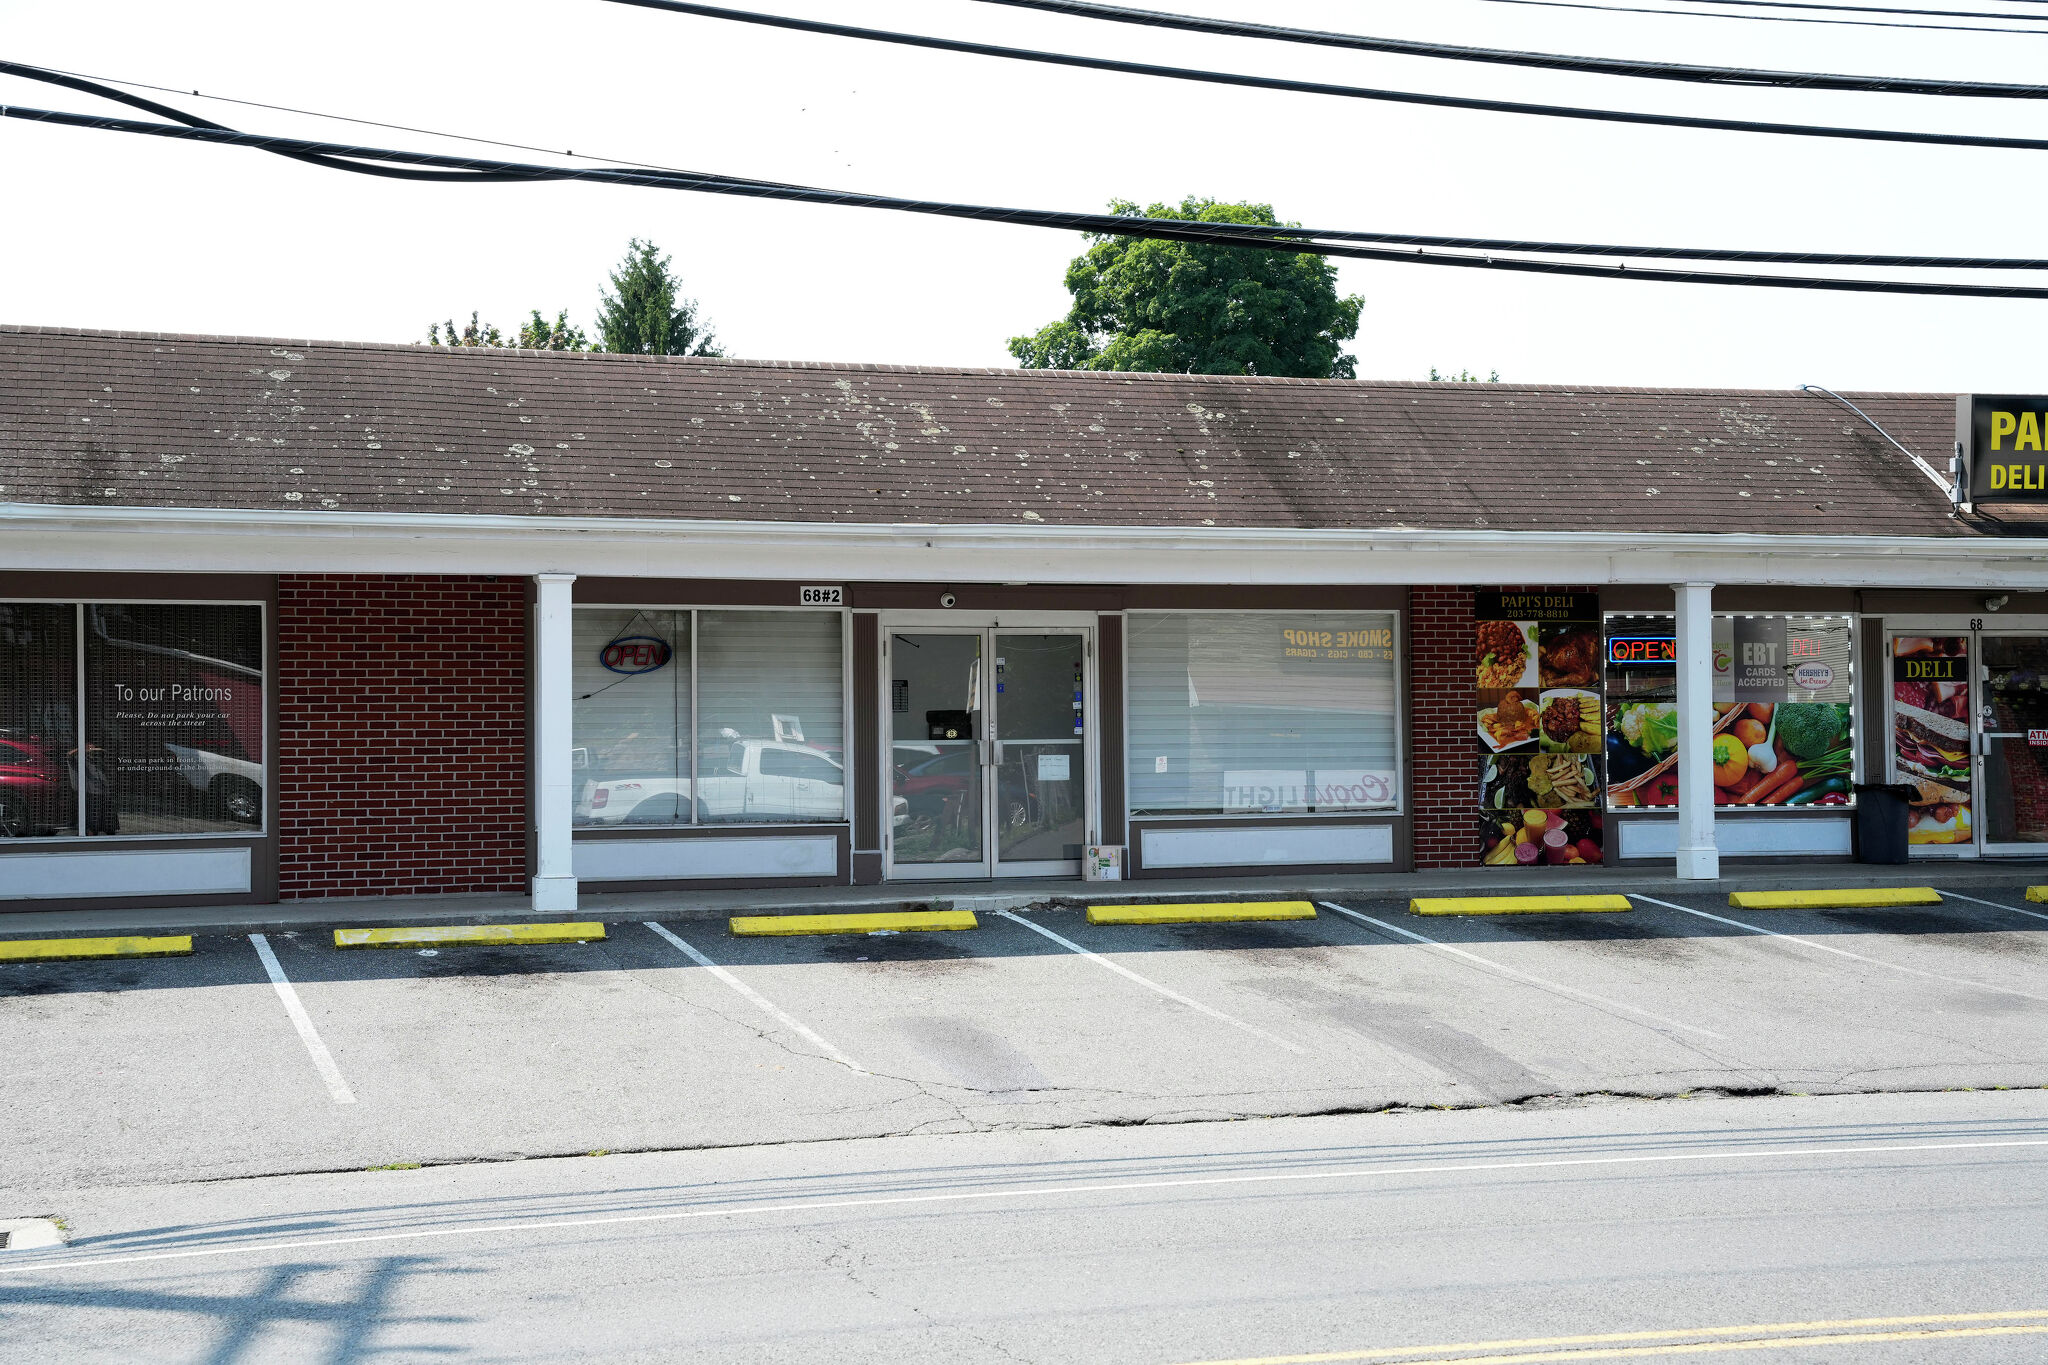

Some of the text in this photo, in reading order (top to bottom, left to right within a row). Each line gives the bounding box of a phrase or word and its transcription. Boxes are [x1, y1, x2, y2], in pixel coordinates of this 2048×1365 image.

[1990, 411, 2048, 451] PA
[1990, 464, 2044, 490] DELI
[803, 589, 840, 603] 68#2
[1501, 596, 1574, 608] PAPI'S DELI
[1507, 610, 1569, 618] 203-778-8810
[1970, 618, 1983, 630] 68
[1613, 641, 1675, 659] OPEN
[1743, 642, 1778, 666] EBT
[1792, 639, 1820, 656] DELI
[604, 645, 666, 666] OPEN
[1745, 667, 1777, 677] CARDS
[1905, 660, 1954, 678] DELI
[1737, 678, 1785, 687] ACCEPTED
[115, 684, 232, 701] To our Patrons
[176, 712, 195, 720] park
[2029, 730, 2048, 740] ATM
[148, 757, 164, 765] park
